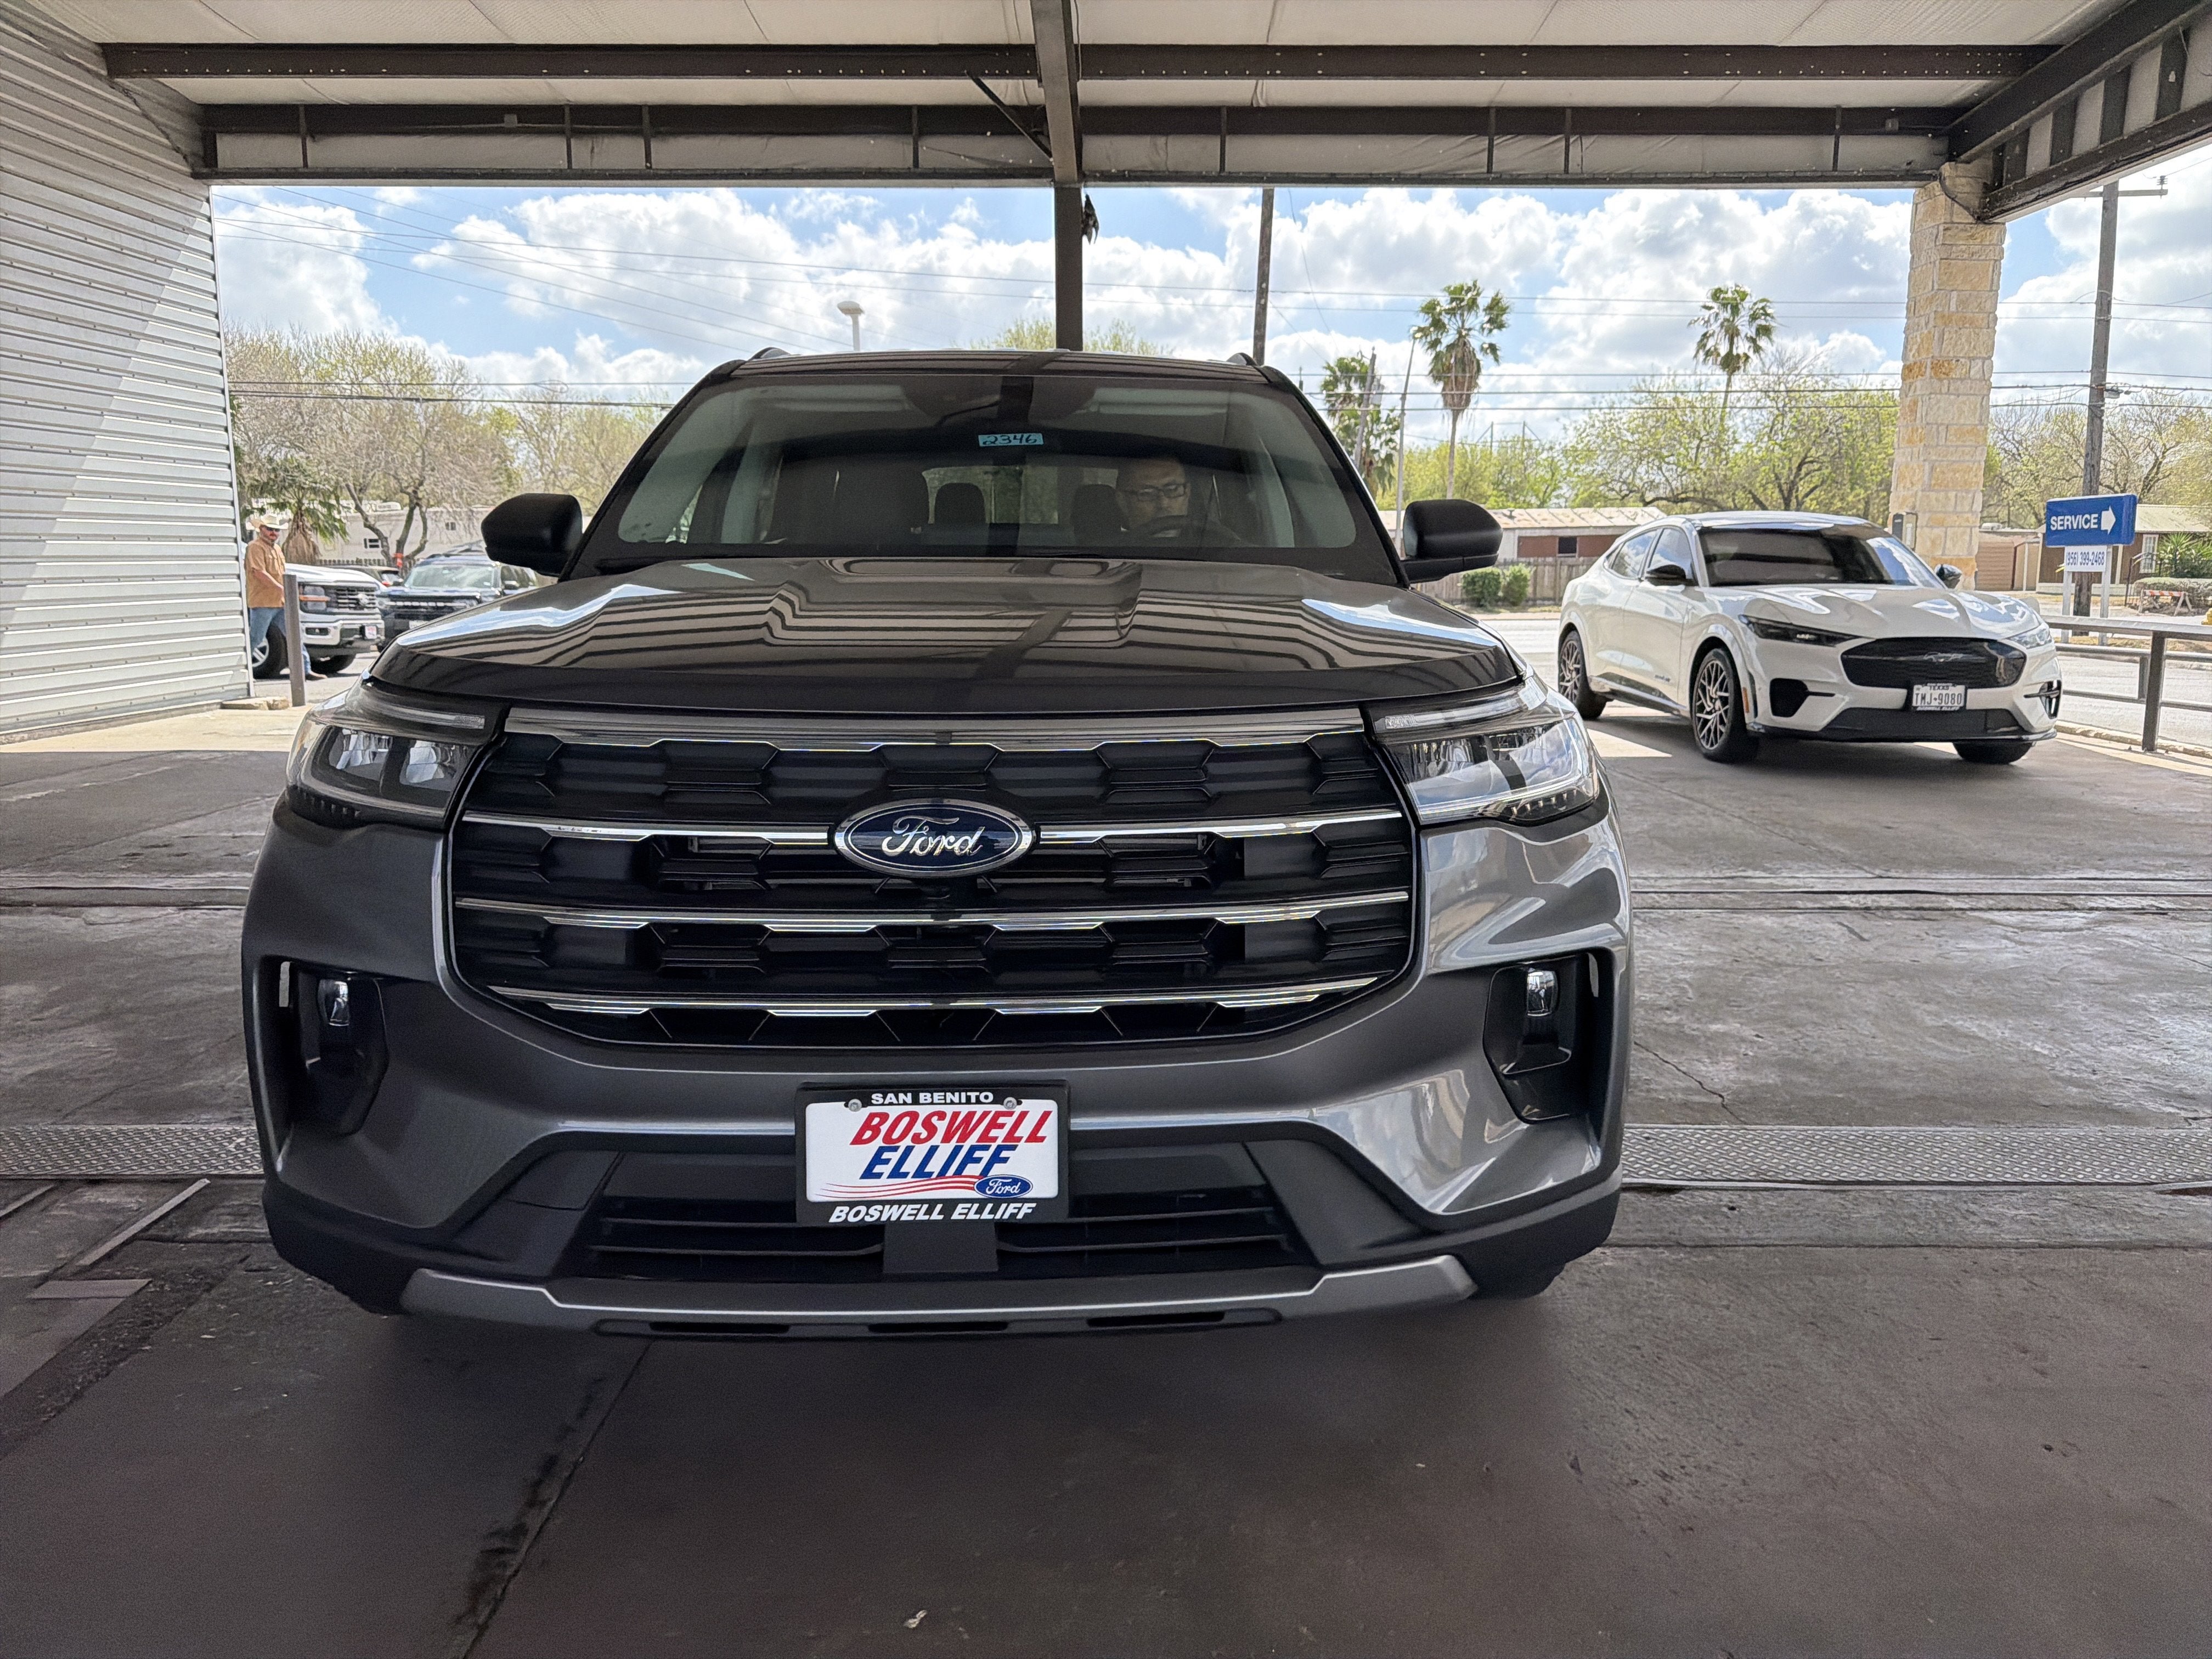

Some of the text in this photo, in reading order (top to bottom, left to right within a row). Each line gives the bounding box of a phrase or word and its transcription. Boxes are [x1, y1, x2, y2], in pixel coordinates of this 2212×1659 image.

[982, 435, 1037, 445] 2346
[2050, 514, 2098, 531] SERVICE
[2066, 551, 2105, 566] (956) 399-2468
[882, 815, 985, 856] Ford
[871, 1092, 994, 1104] SAN BENITO
[849, 1110, 1053, 1146] BOSWELL
[859, 1144, 1019, 1180] ELLIFF
[985, 1179, 1022, 1195] Ford
[828, 1203, 1037, 1223] BOSWELL ELLIFF
